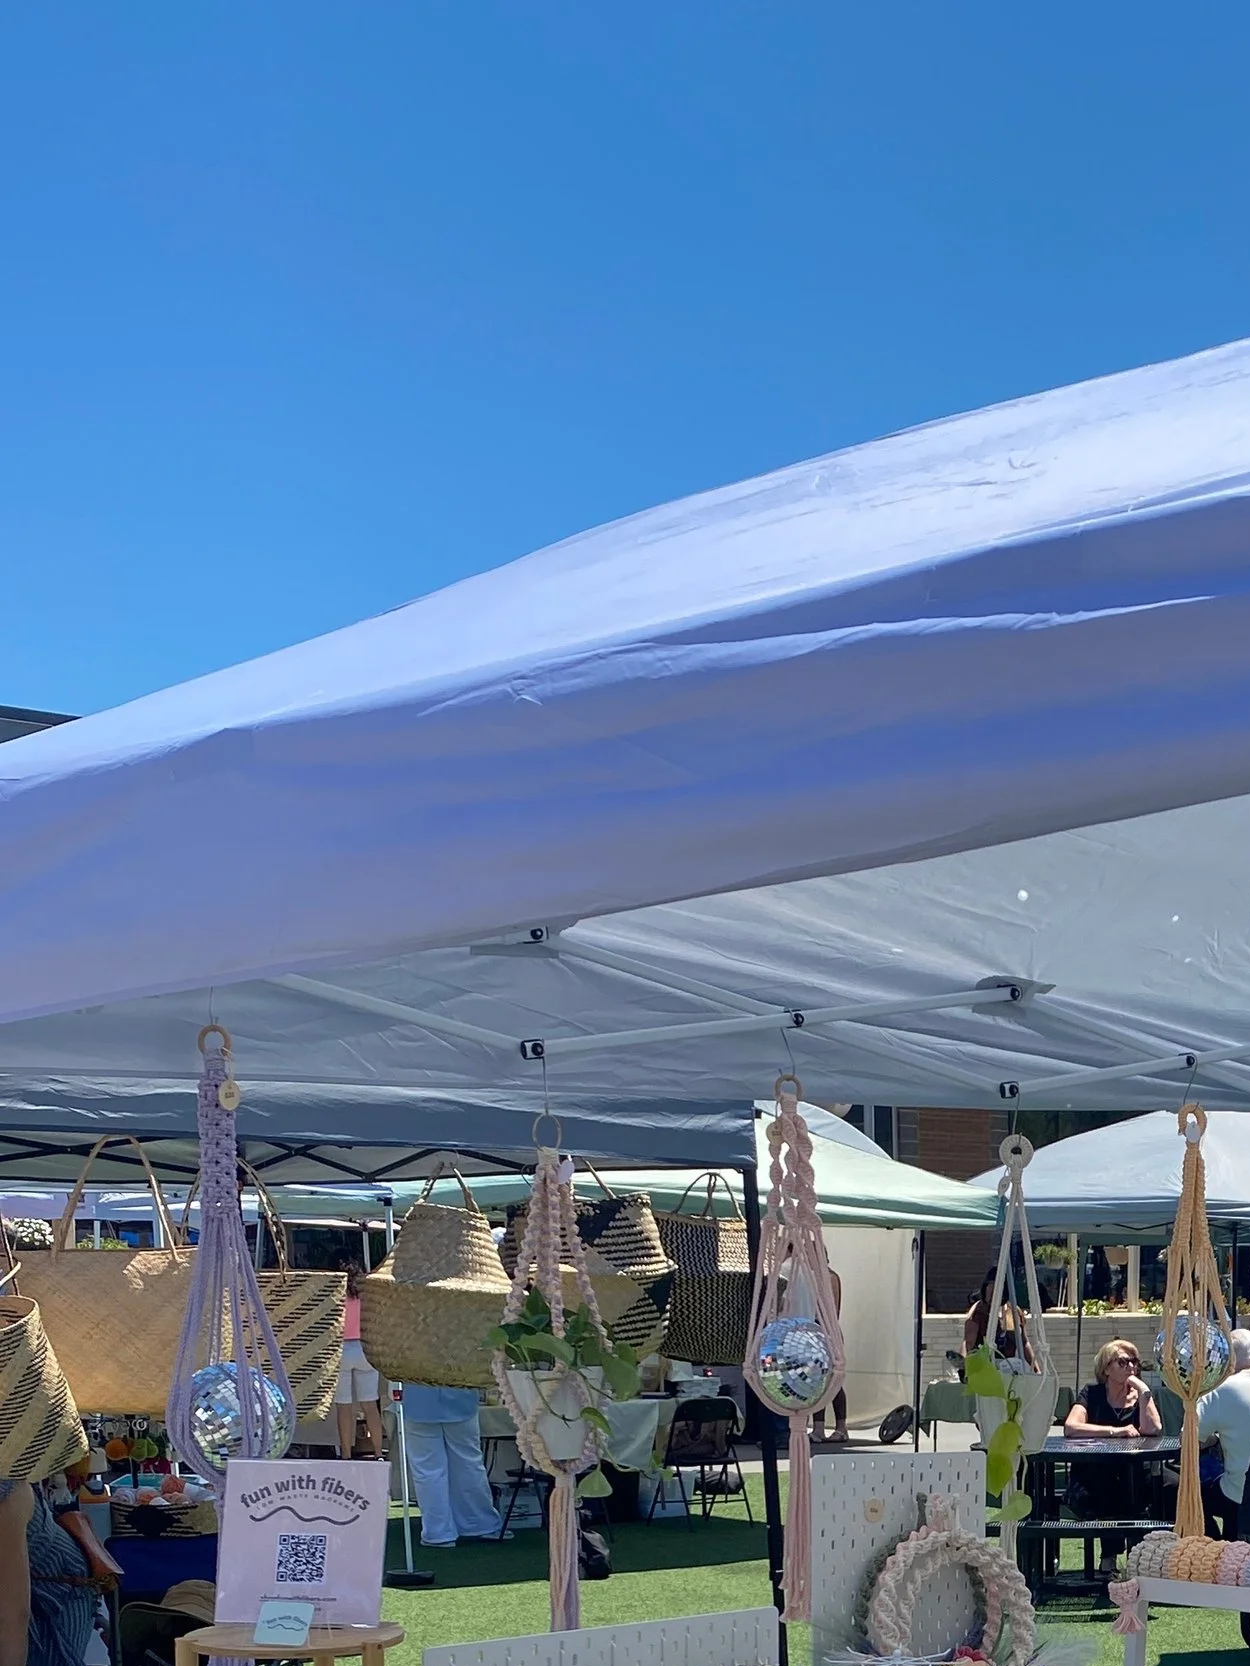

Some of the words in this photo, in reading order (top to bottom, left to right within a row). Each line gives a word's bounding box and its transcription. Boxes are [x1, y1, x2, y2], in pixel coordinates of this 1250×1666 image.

[240, 1485, 272, 1509] fun
[274, 1474, 317, 1493] with
[320, 1477, 370, 1511] fibers
